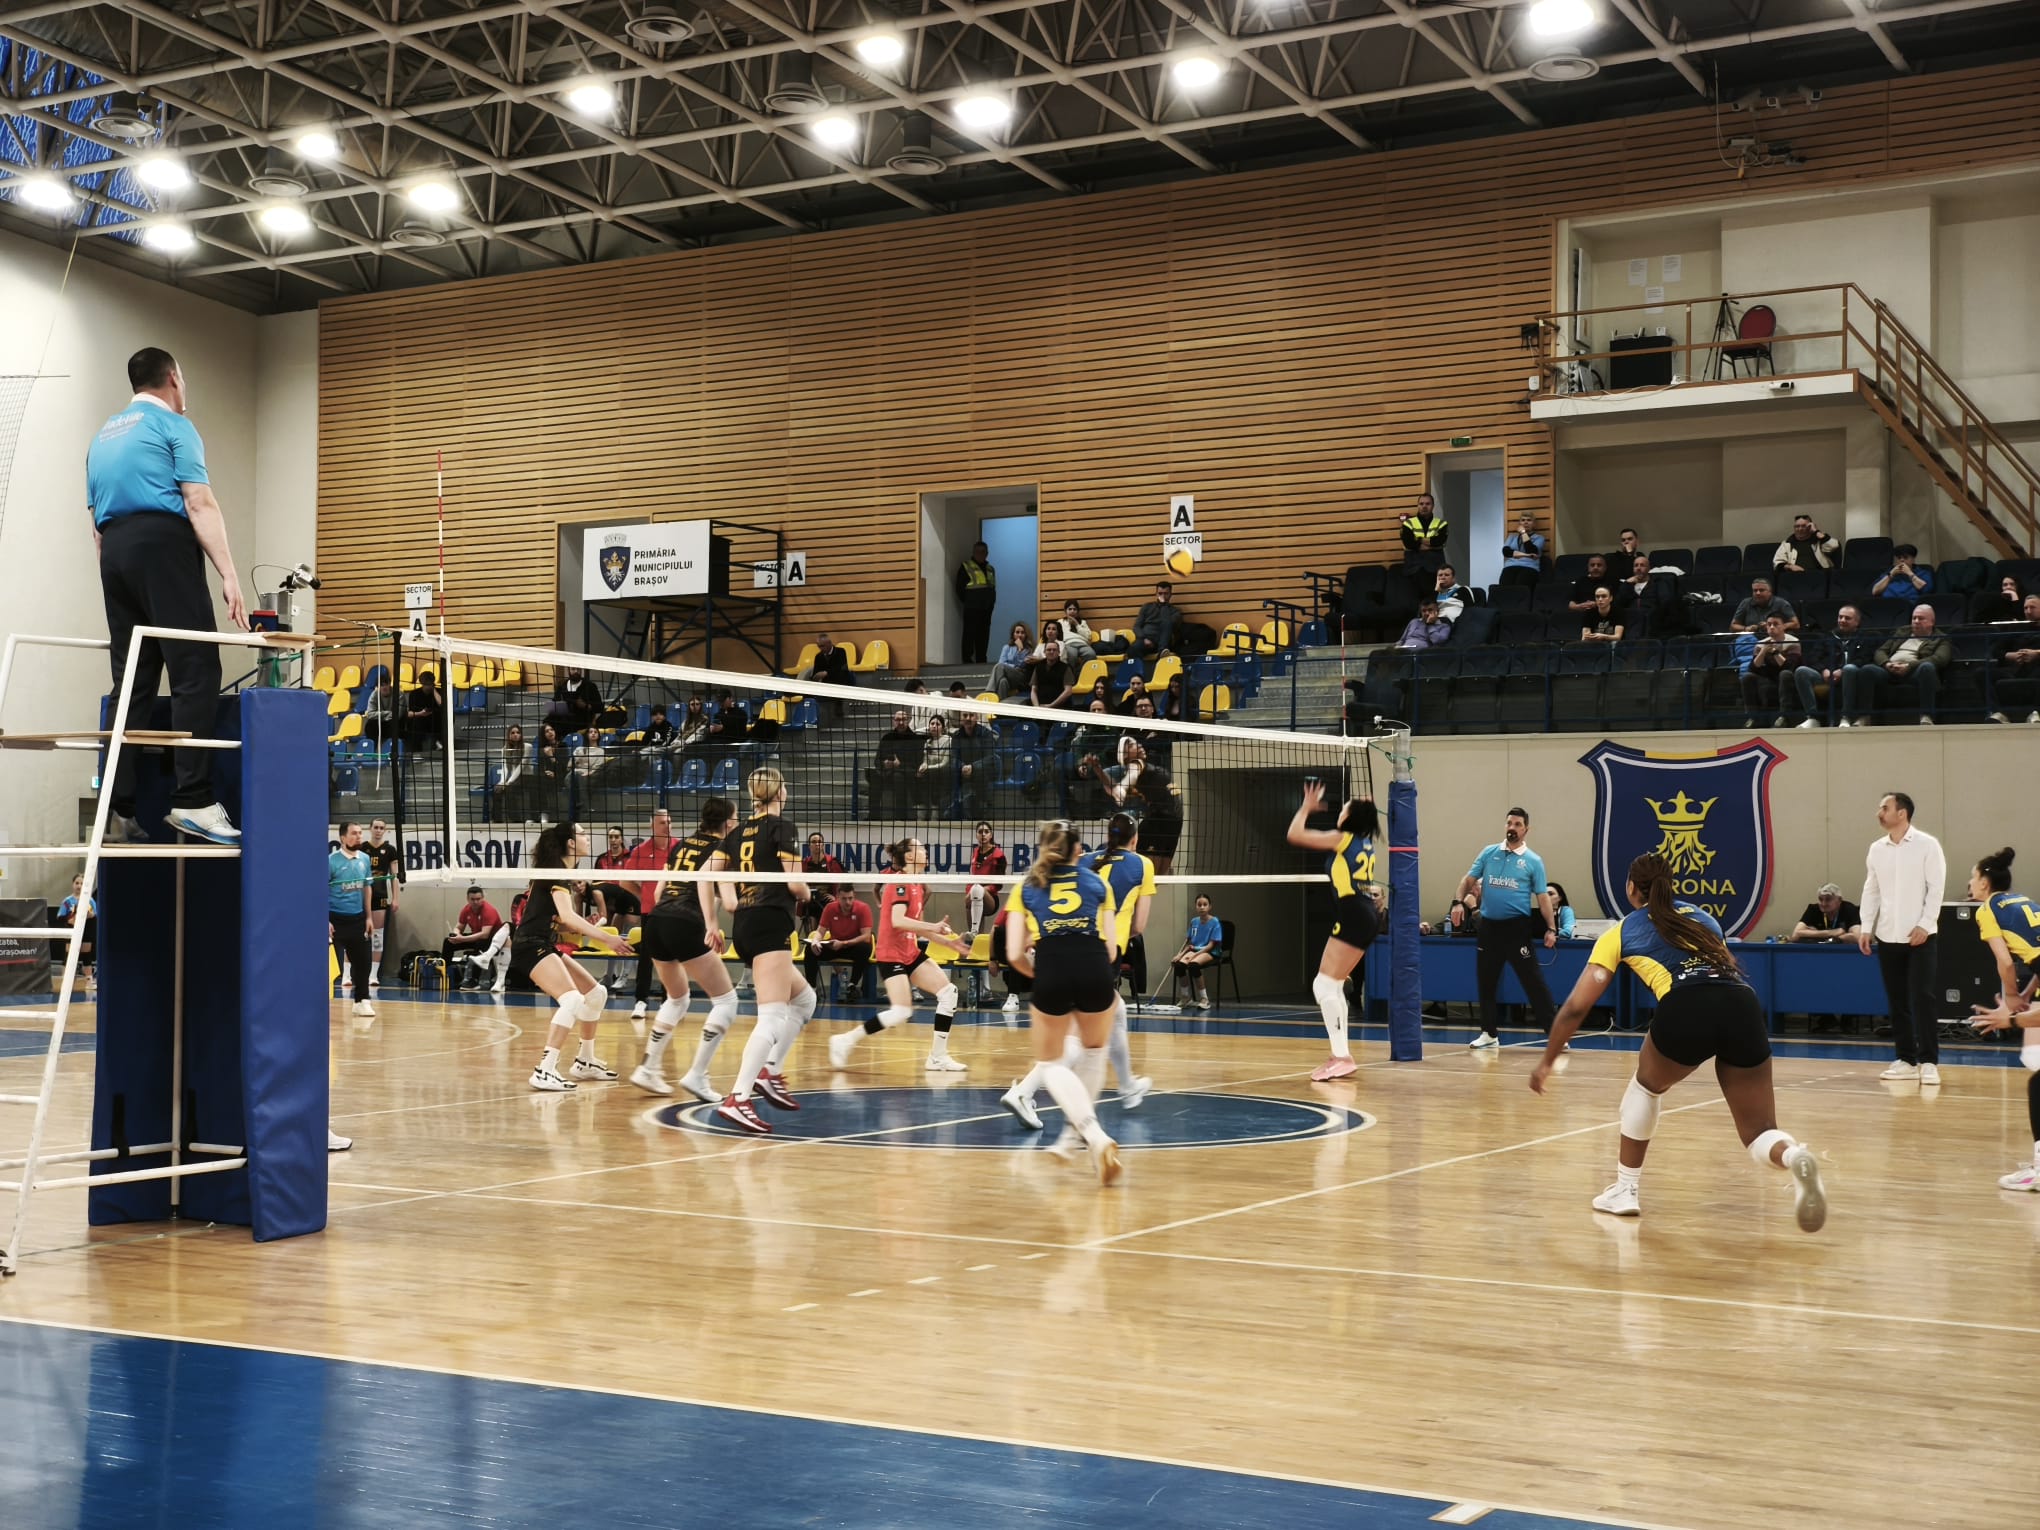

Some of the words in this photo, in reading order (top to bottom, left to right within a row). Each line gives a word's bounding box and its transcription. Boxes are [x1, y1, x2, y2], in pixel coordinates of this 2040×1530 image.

[1173, 505, 1191, 527] A
[1165, 536, 1200, 546] SECTOR
[634, 547, 676, 560] PRIMĂRIA
[634, 561, 693, 573] MUNICIPIULUI
[788, 561, 803, 581] A
[634, 576, 668, 588] BRAȘOV
[767, 575, 773, 585] 2
[406, 586, 432, 594] SECTOR
[416, 597, 421, 605] 1
[740, 840, 755, 872] 8
[1672, 879, 1737, 895] RONA
[1048, 881, 1082, 915] 5
